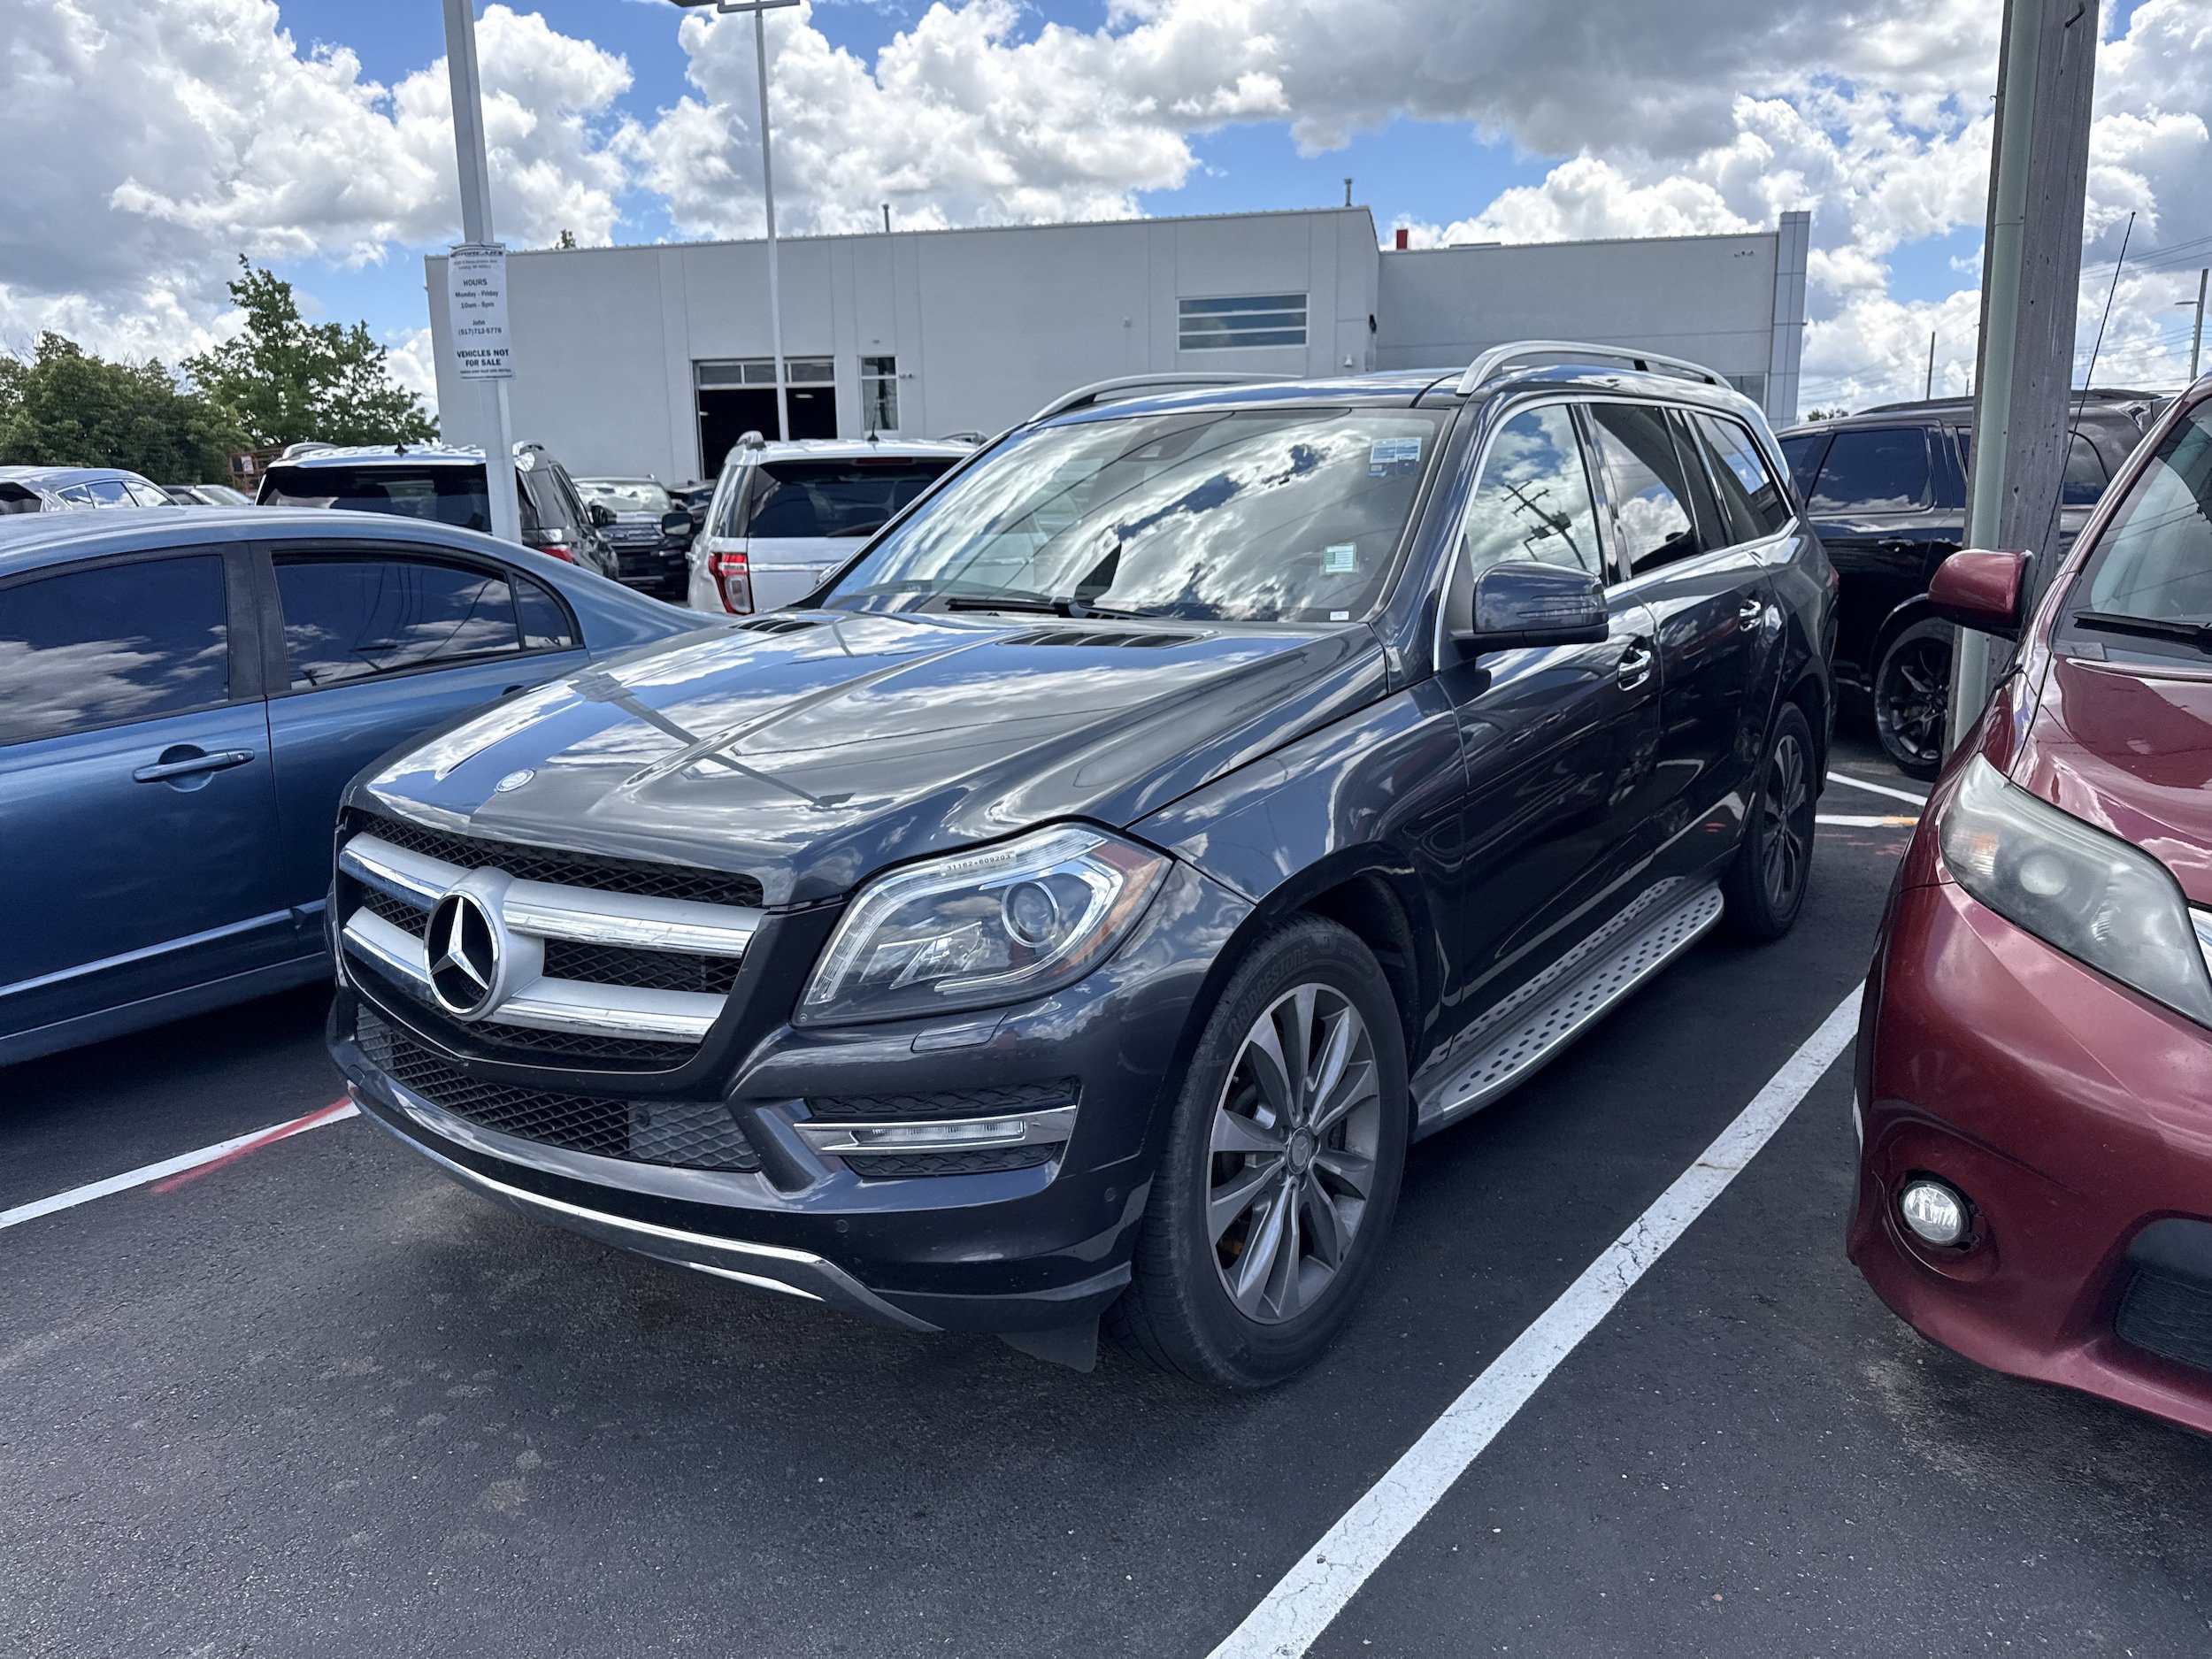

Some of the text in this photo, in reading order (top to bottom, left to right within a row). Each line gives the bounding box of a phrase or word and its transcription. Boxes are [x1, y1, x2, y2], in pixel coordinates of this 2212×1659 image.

[463, 278, 488, 287] HOURS
[457, 349, 510, 358] VEHICLES NOT
[1226, 944, 1310, 1041] BRIDGESTONE
